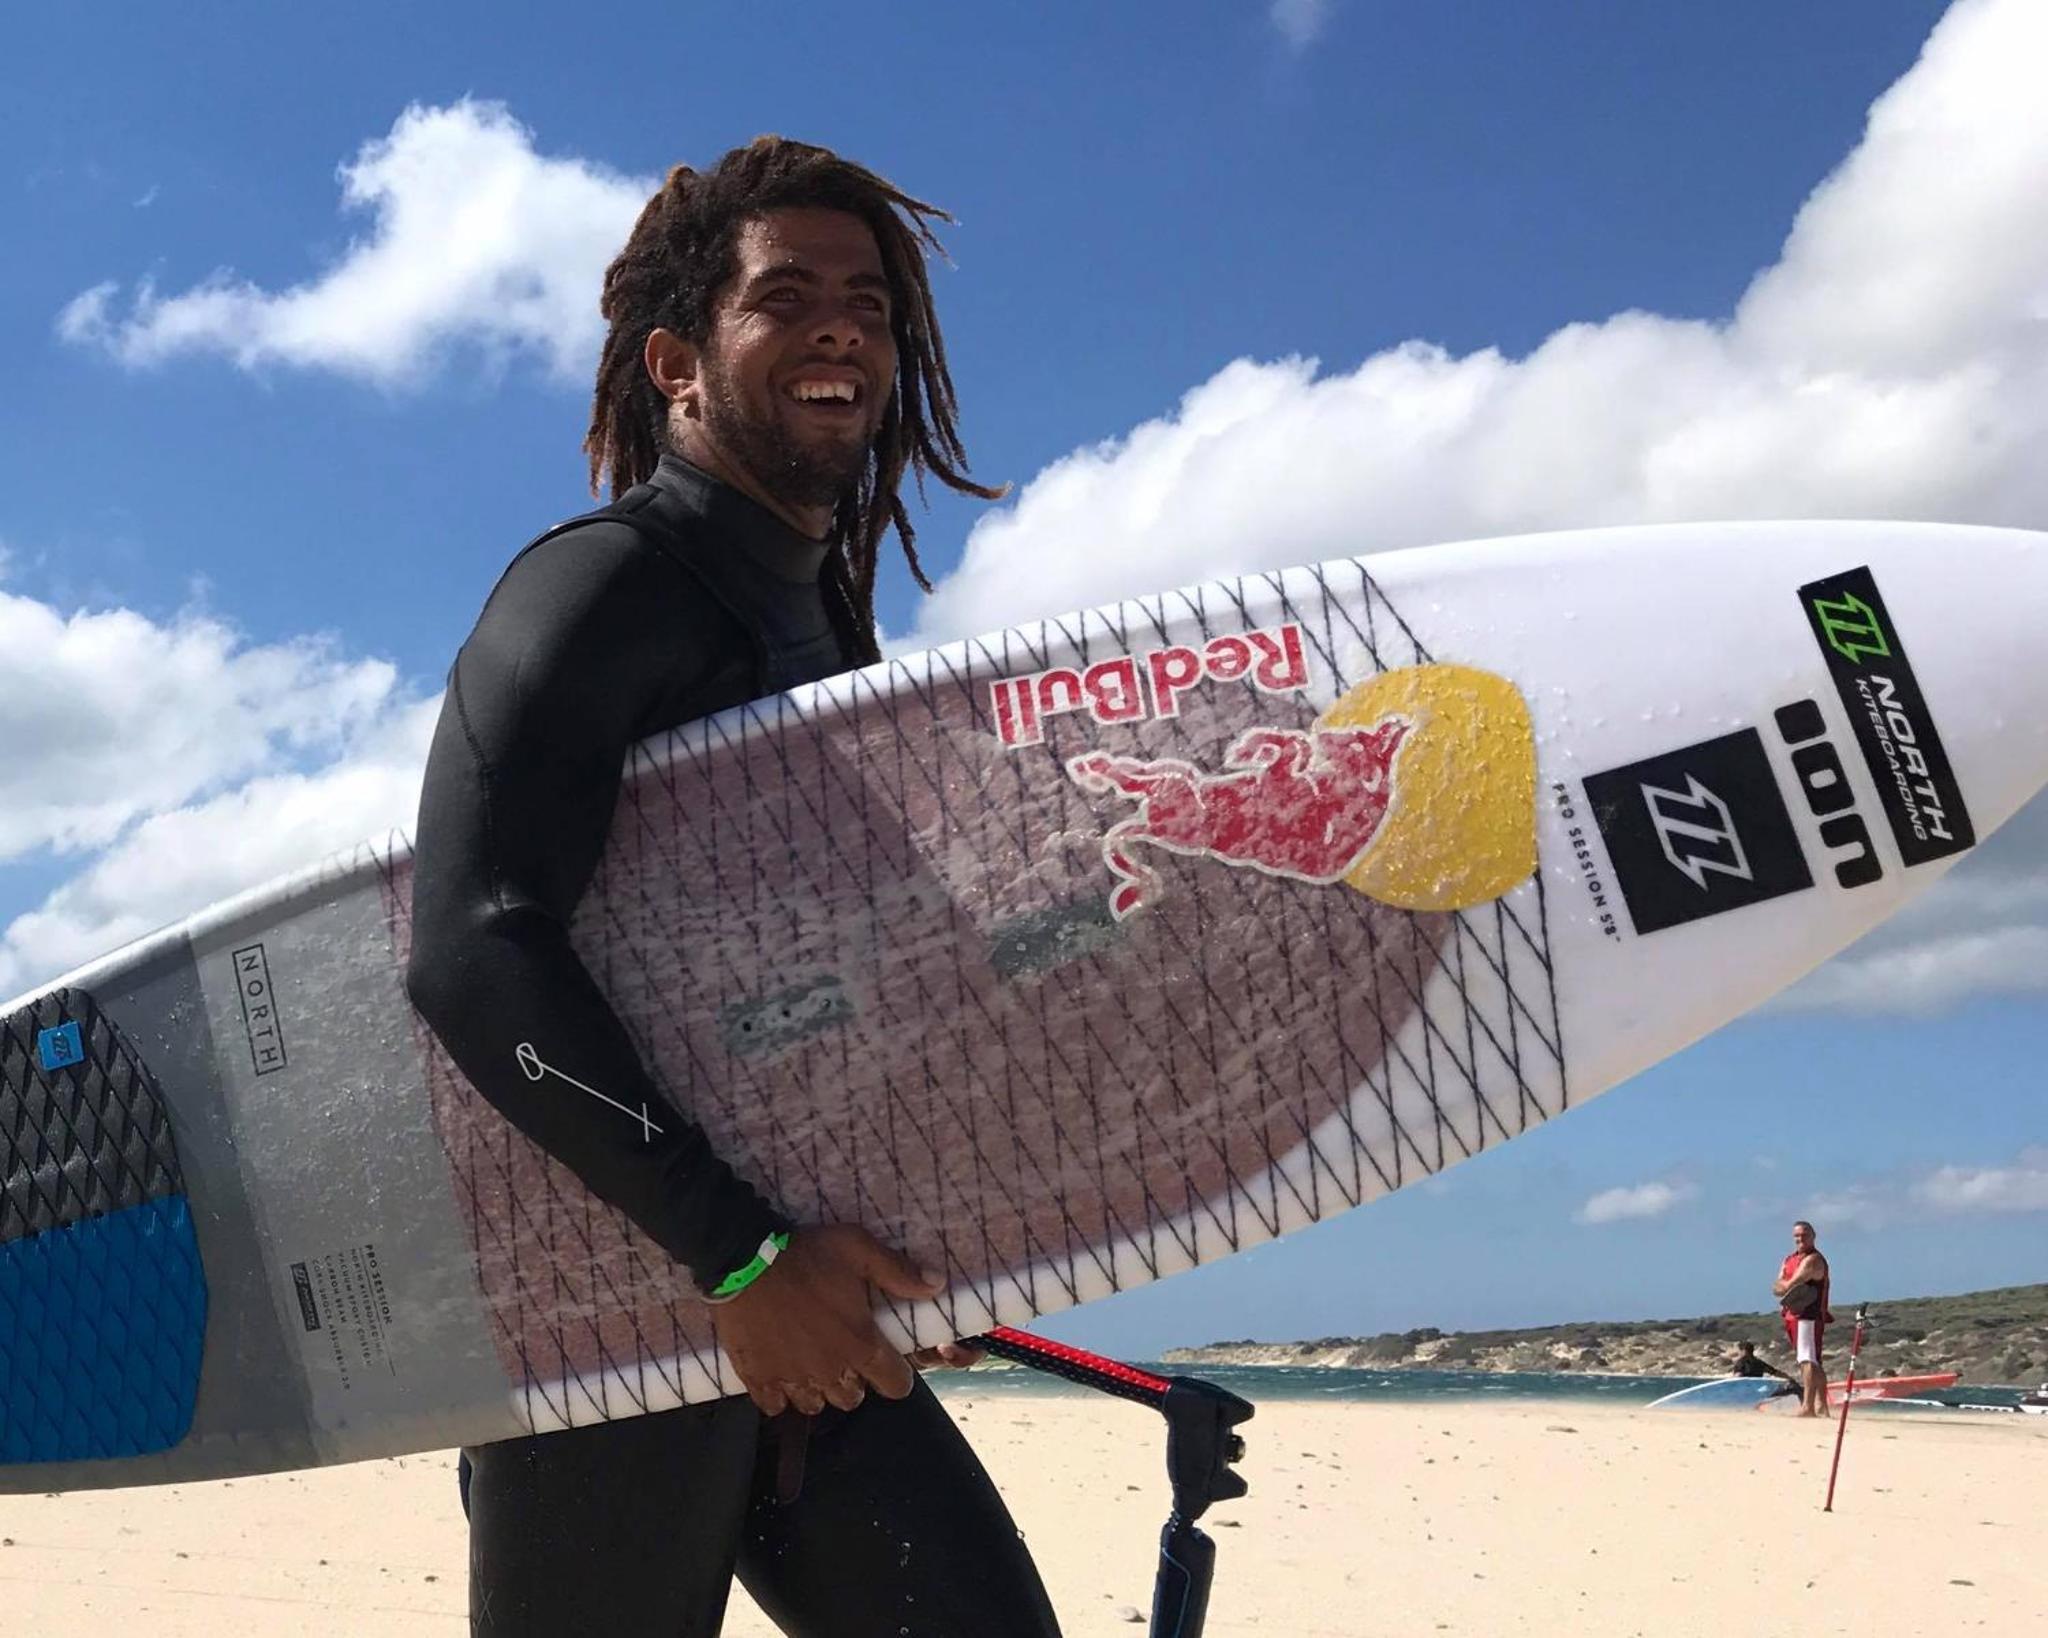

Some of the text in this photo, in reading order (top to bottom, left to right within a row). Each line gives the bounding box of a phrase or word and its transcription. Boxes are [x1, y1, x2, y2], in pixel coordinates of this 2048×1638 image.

[991, 624, 1310, 749] Red Bull
[1855, 678, 1928, 841] KITEBOARDING
[1870, 675, 1954, 841] NORTH
[1552, 783, 1575, 819] PRO
[1568, 827, 1607, 908] SESSION
[241, 955, 279, 1064] NORTH
[365, 1243, 393, 1325] PRO SESSION
